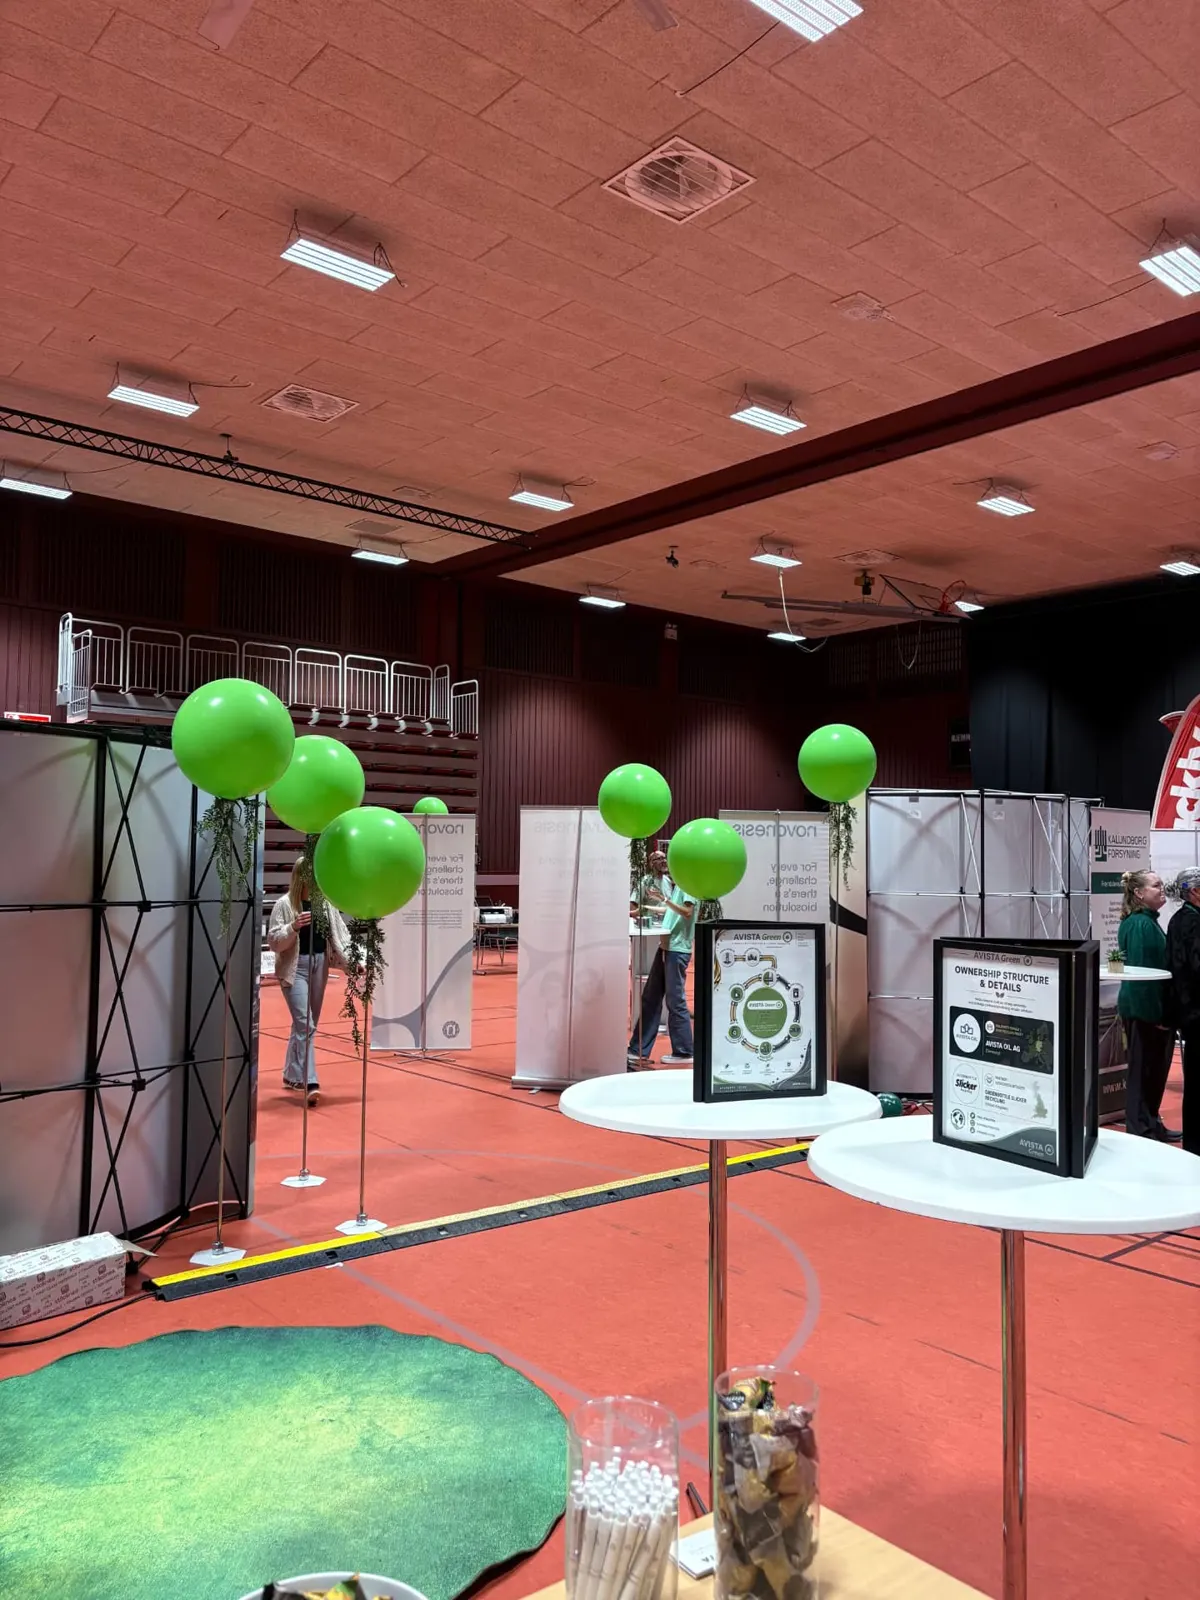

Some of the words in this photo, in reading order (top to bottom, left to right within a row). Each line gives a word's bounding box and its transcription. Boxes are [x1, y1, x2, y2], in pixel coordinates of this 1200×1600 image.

[1108, 834, 1147, 846] KALUNDBORG
[1108, 849, 1140, 859] FORSYNING
[973, 952, 1000, 961] AVISTA
[1001, 954, 1021, 964] Green
[955, 965, 1001, 978] OWNERSHIP
[1003, 972, 1049, 985] STRUCTURE
[980, 980, 985, 988] &
[988, 980, 1022, 992] DETAILS
[985, 1040, 1002, 1048] AVISTA
[955, 1078, 977, 1091] Slicker
[1020, 1138, 1044, 1151] AVISTA
